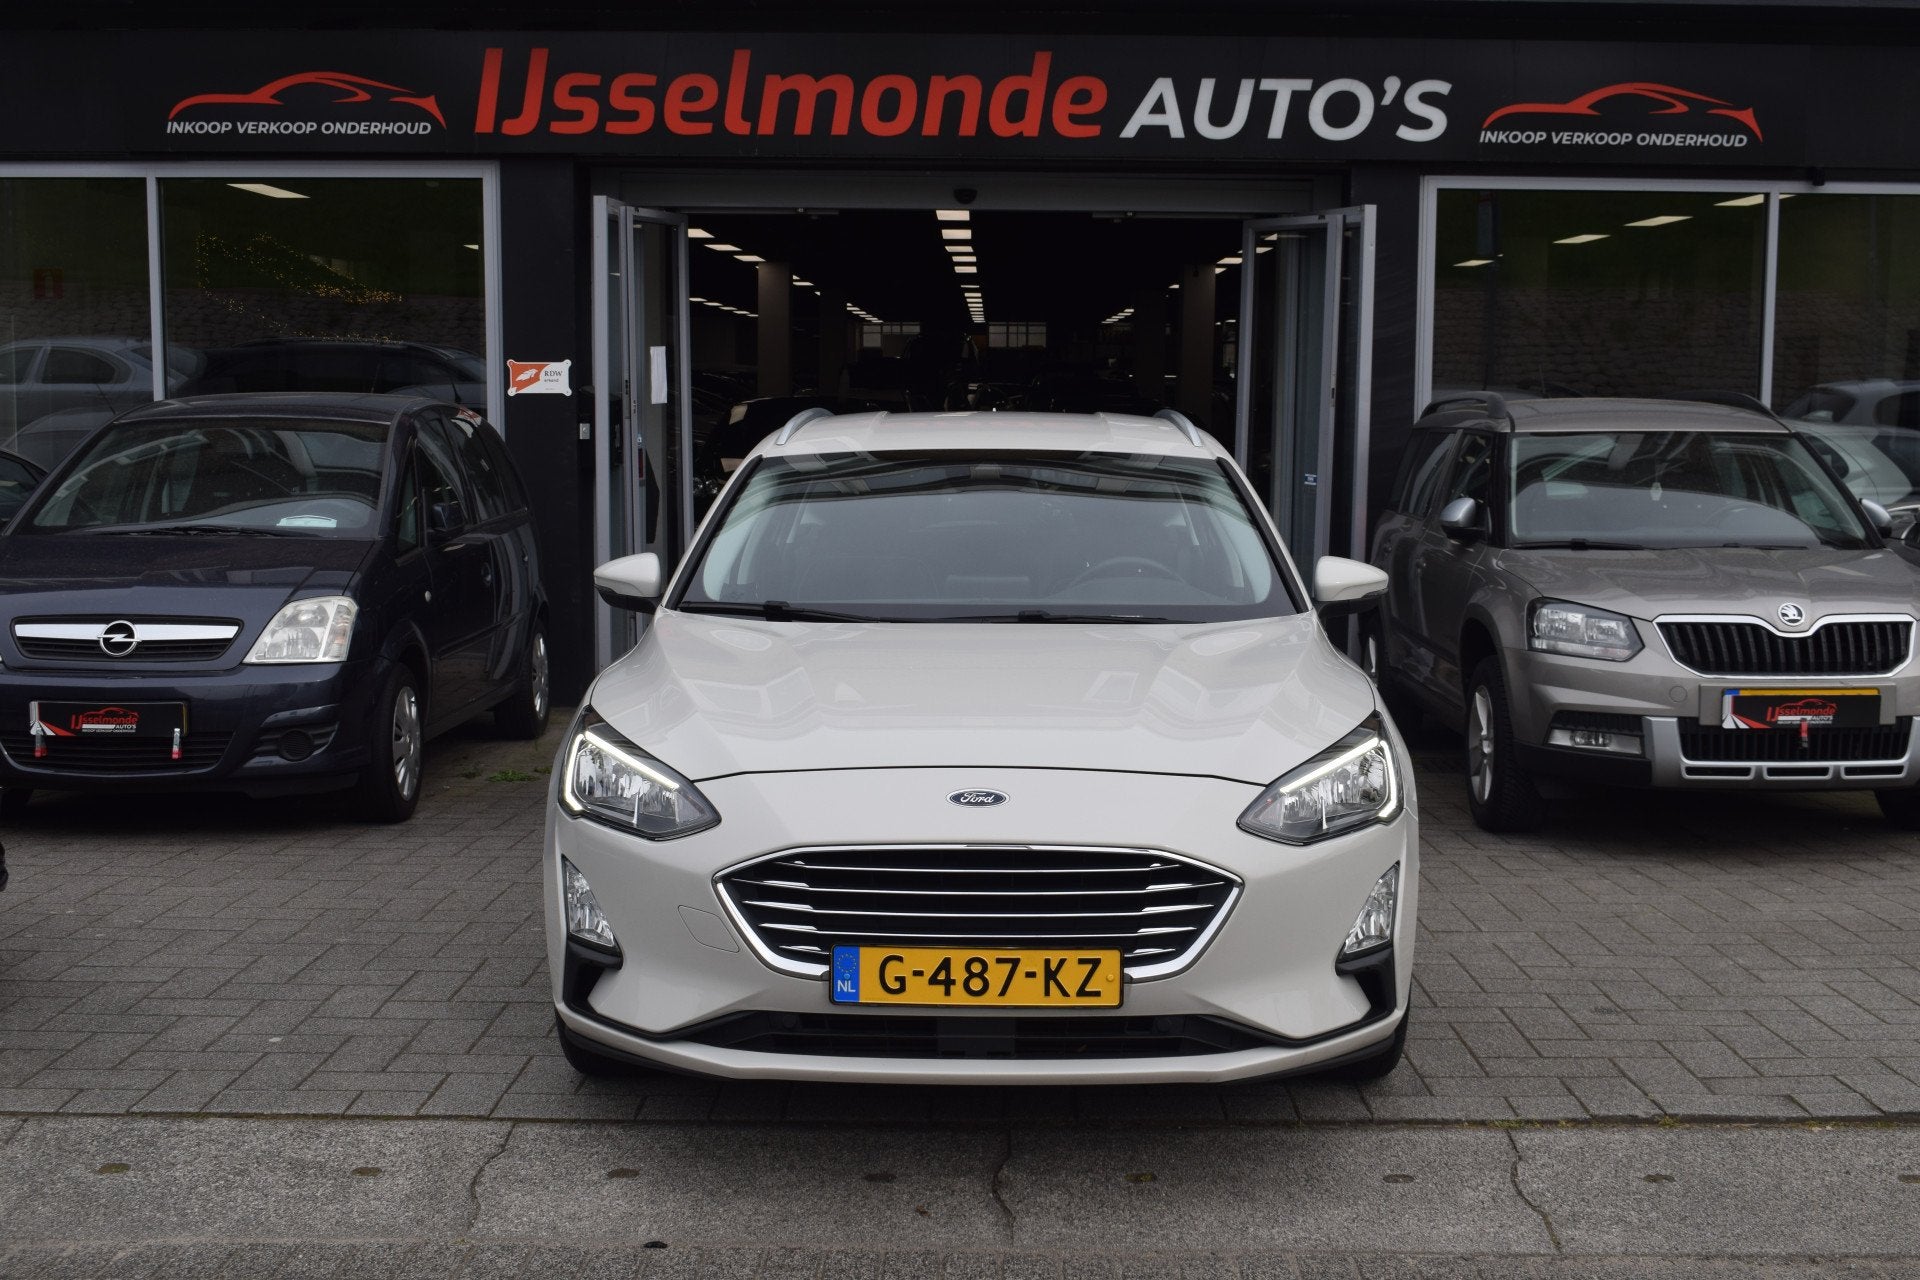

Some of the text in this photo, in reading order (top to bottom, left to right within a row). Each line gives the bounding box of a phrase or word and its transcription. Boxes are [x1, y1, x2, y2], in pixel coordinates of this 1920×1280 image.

[474, 48, 1453, 142] IJsselmonde AUTO'S
[166, 121, 432, 135] INKOOP VERKOOP ONDERHOUD
[1479, 130, 1747, 147] INKOOP VERKOOP ONDERHOUD
[1766, 706, 1835, 721] IJsselmonde
[71, 714, 137, 729] IJsselmonde
[960, 792, 995, 803] Ford
[879, 955, 1102, 998] G-487-KZ
[837, 980, 856, 993] NL
